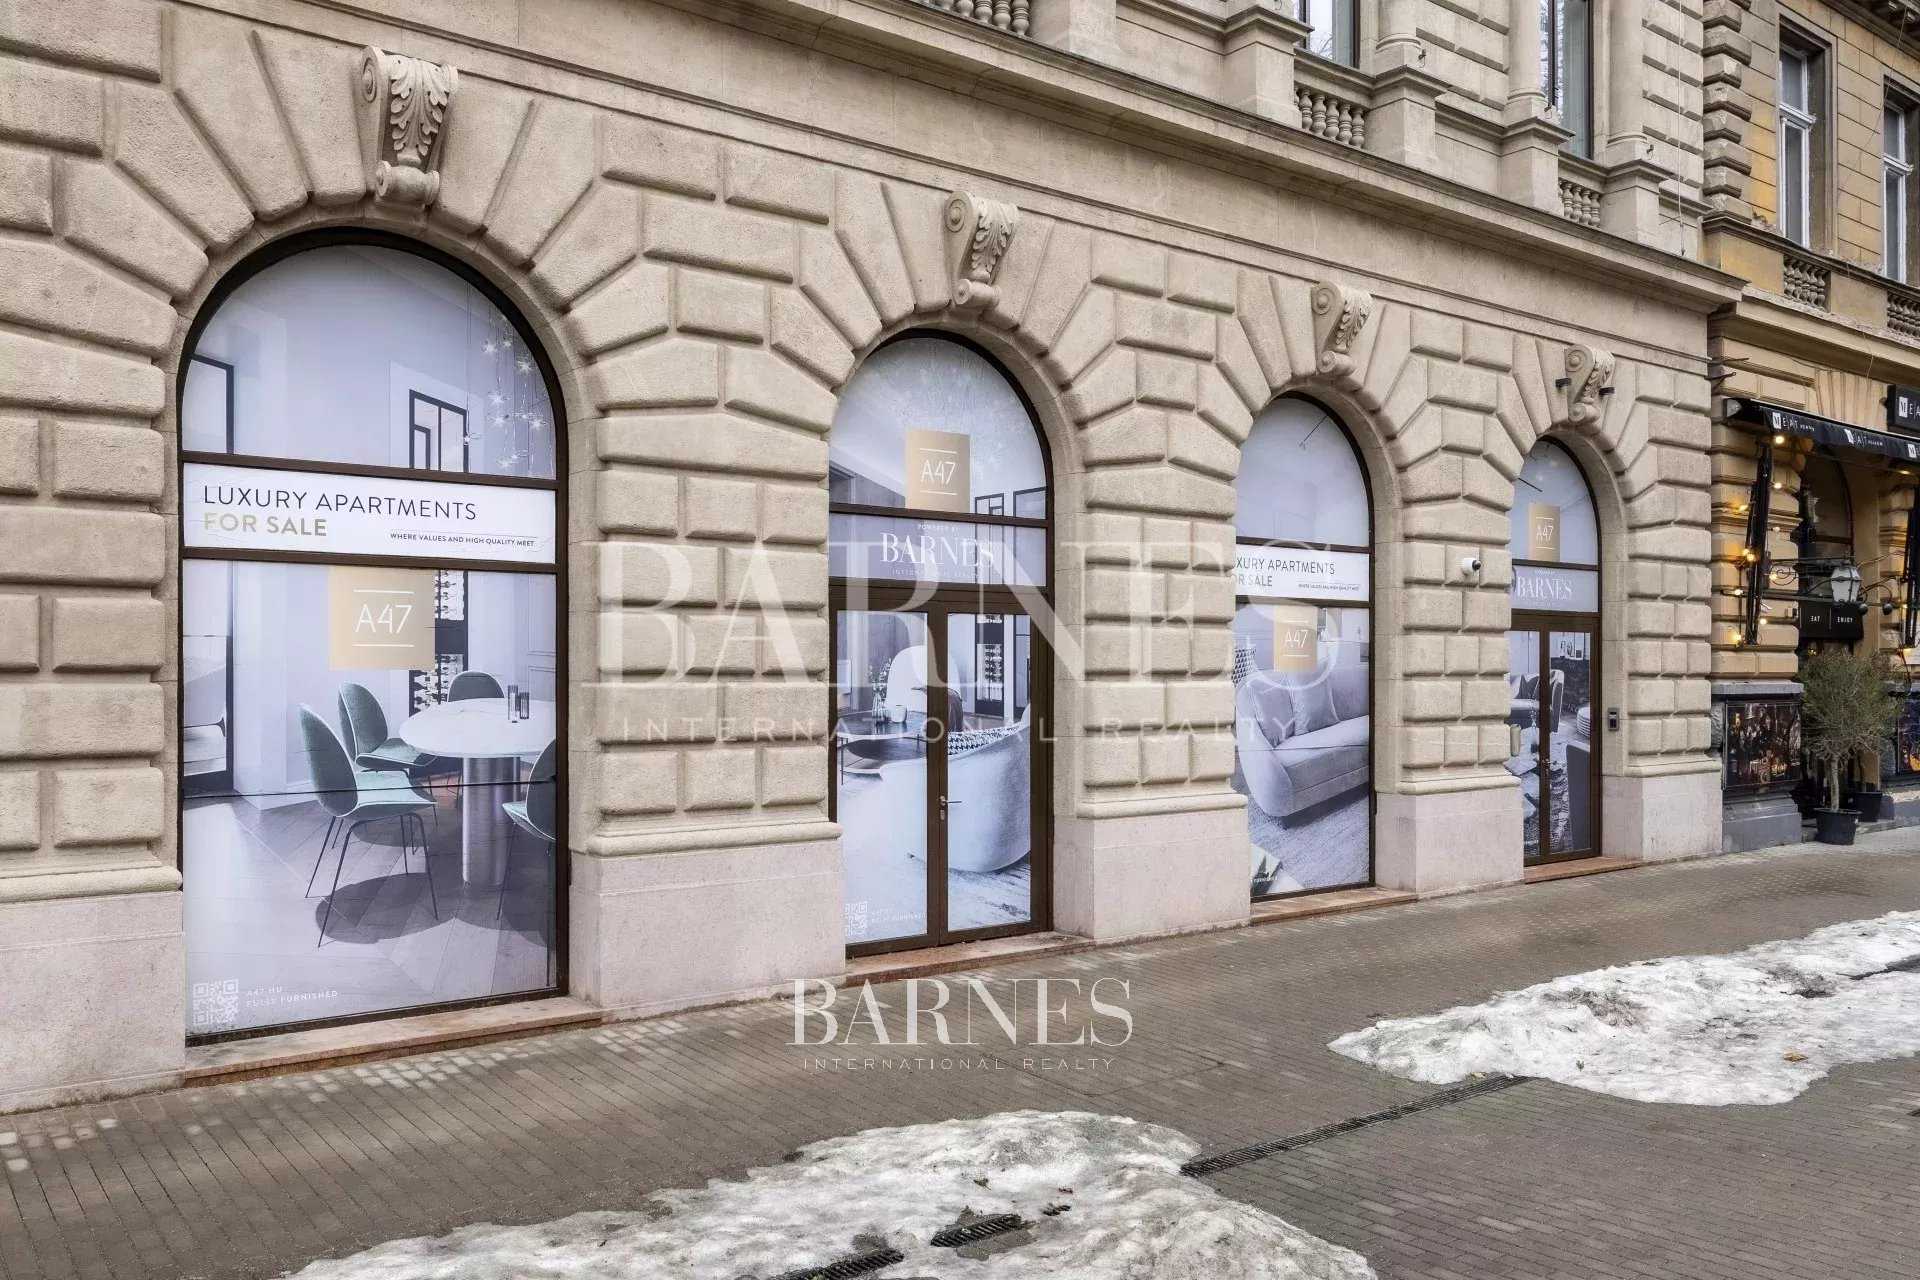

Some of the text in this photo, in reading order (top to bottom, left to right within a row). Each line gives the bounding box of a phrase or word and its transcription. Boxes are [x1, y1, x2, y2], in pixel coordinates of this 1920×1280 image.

[920, 460, 956, 486] A47
[204, 485, 477, 521] LUXURY APARTMENTS
[204, 512, 327, 537] FOR SALE
[1536, 525, 1554, 542] A47
[390, 533, 417, 541] WHERE
[486, 538, 515, 546] QUALITY
[880, 531, 994, 568] BARNES
[1267, 560, 1335, 575] APARTMENTS
[1248, 574, 1273, 587] SALE
[1517, 574, 1573, 600] BARNES
[354, 604, 413, 636] A47
[1284, 628, 1309, 650] A47
